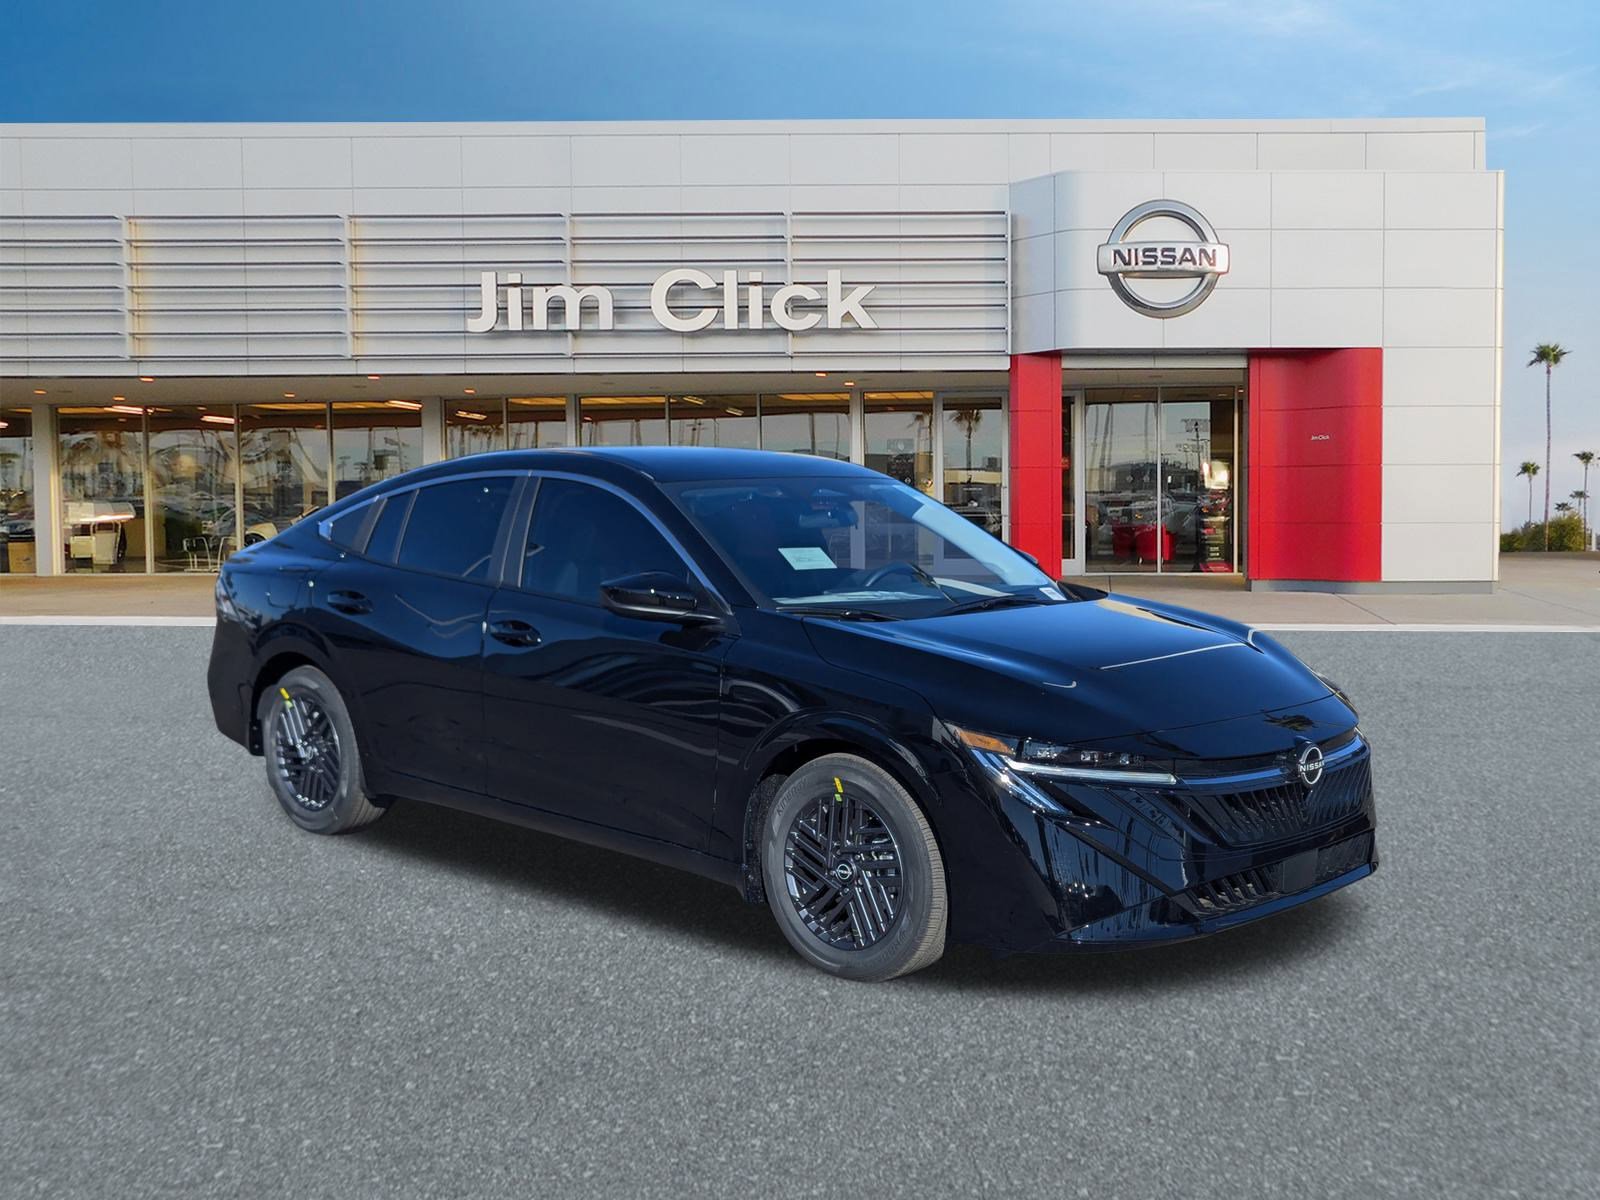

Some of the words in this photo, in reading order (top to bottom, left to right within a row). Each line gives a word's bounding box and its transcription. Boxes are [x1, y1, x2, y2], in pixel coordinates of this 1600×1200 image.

[1112, 247, 1217, 266] NISSAN
[467, 270, 614, 333] Jim
[650, 268, 879, 332] Click
